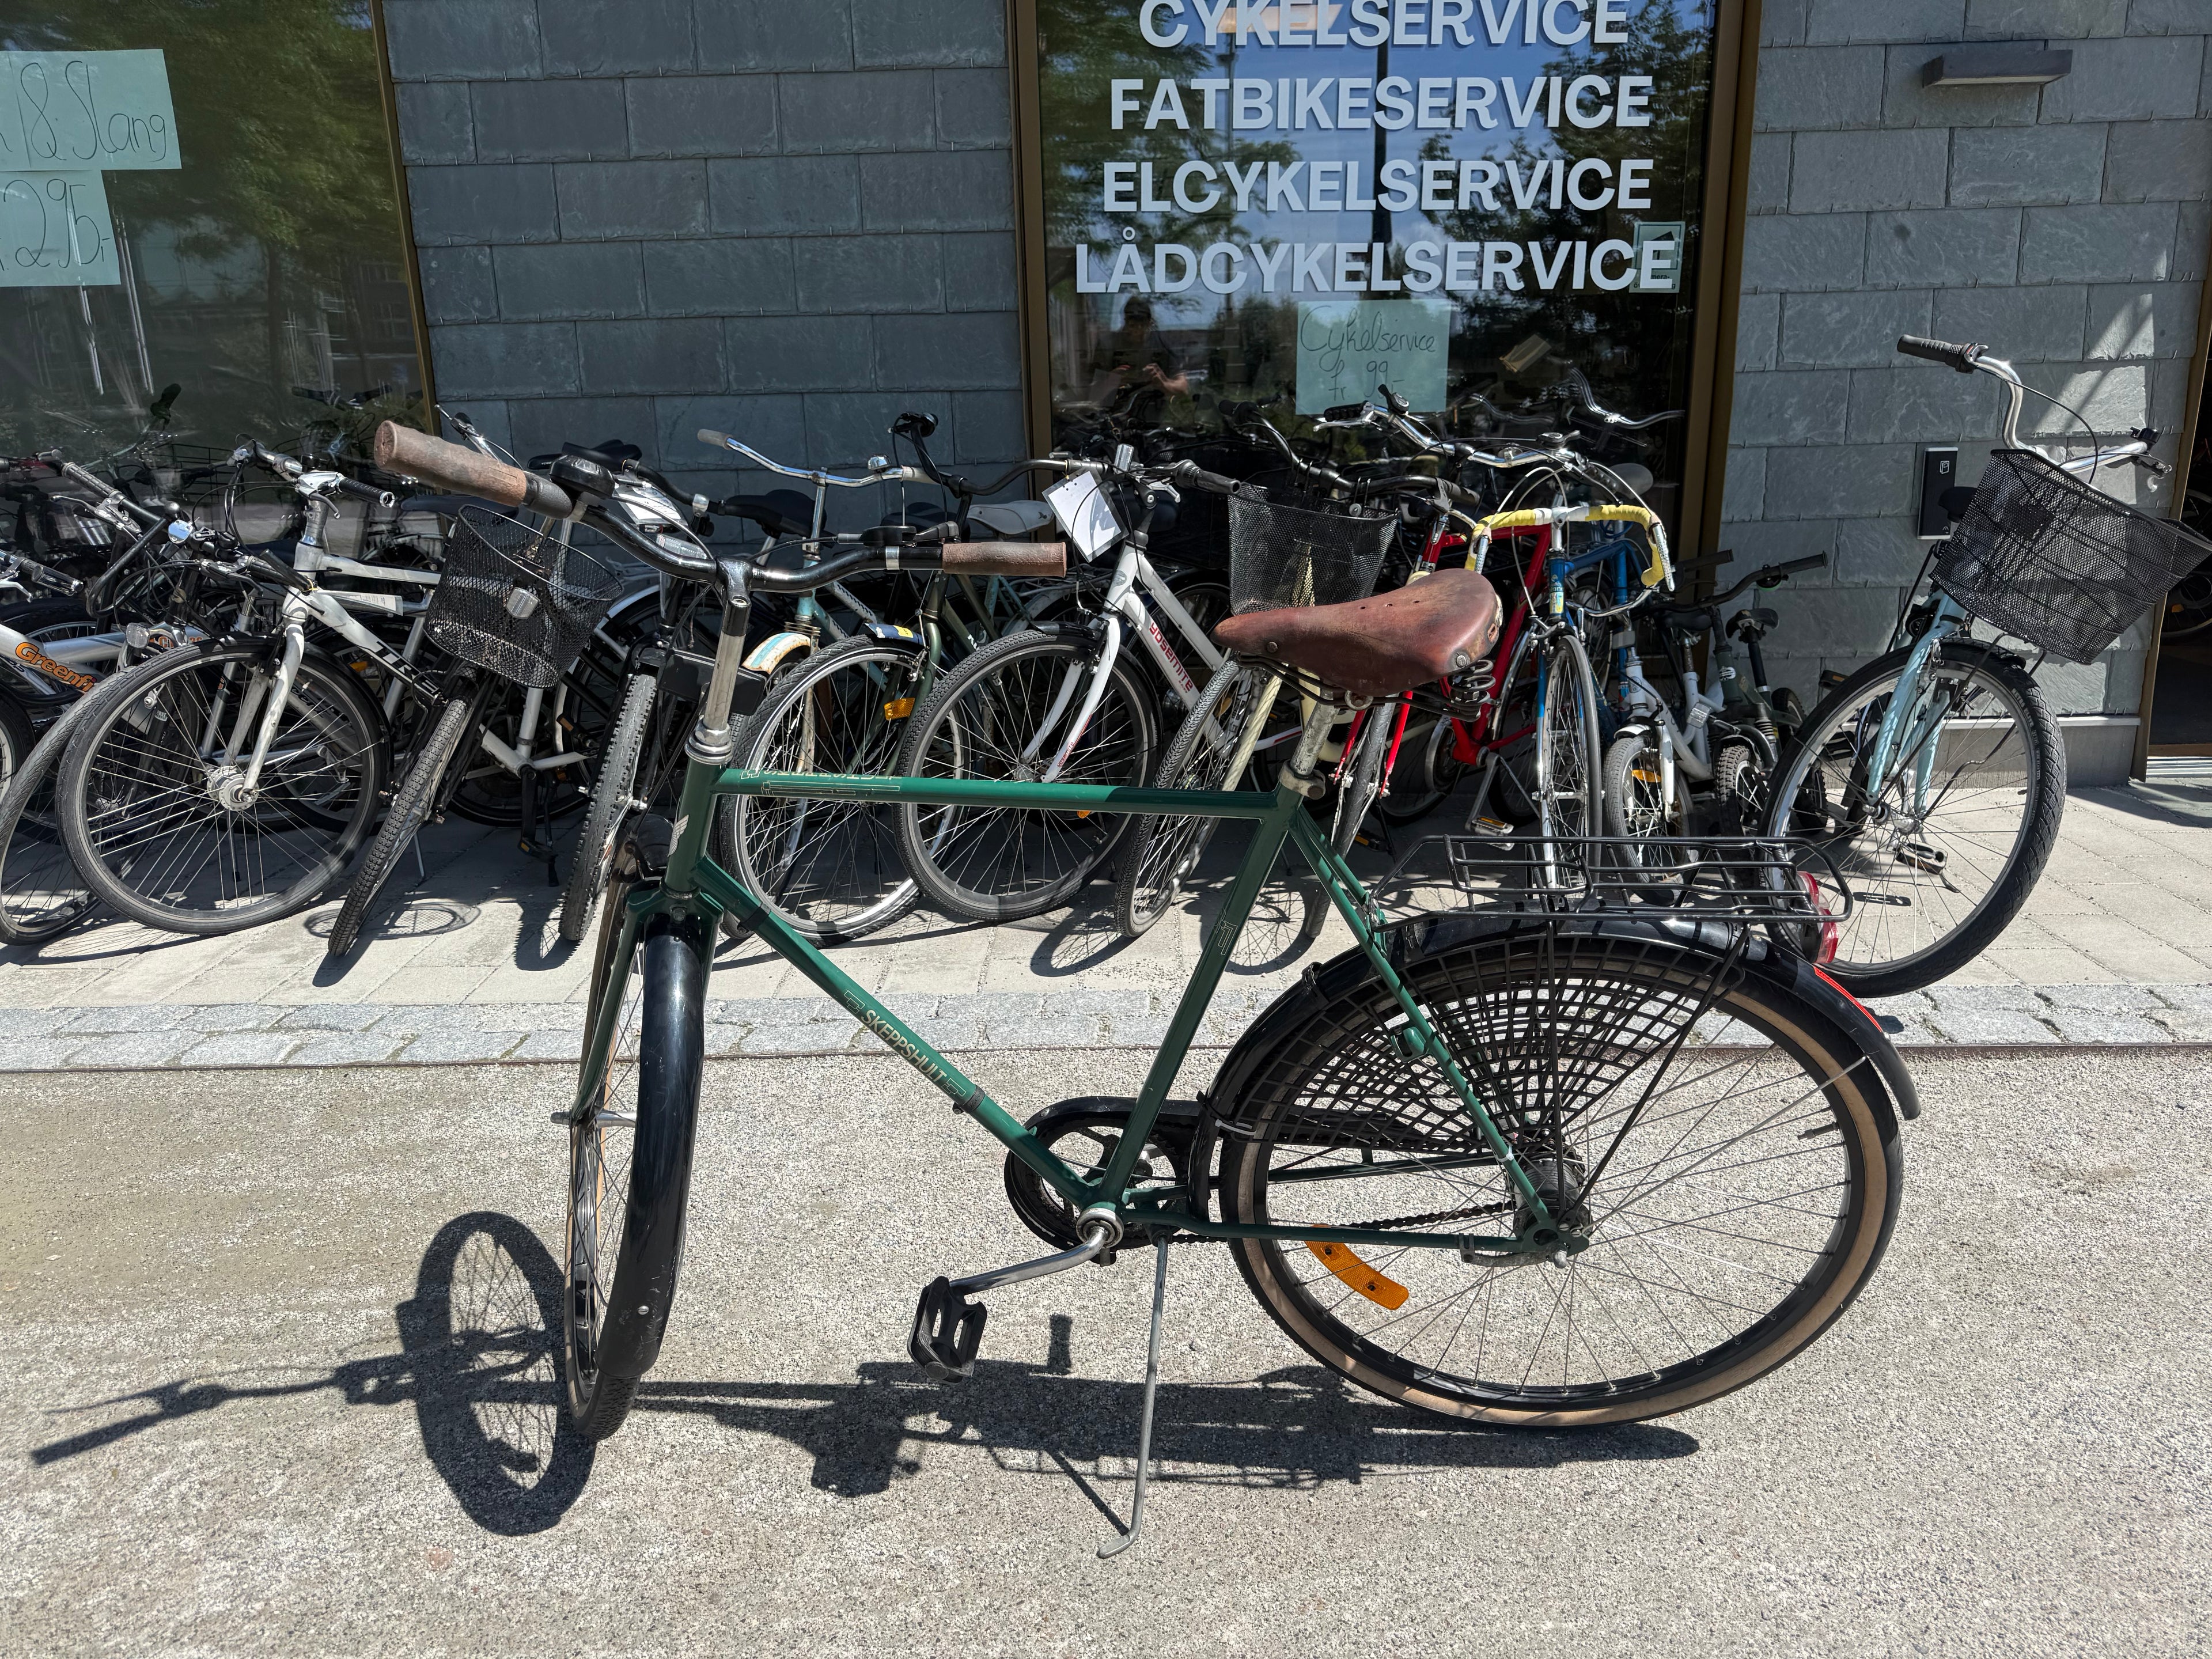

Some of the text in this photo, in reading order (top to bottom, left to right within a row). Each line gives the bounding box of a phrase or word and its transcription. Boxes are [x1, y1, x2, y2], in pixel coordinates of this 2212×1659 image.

[1139, 0, 1629, 48] CYKELSERVICE
[1110, 74, 1652, 131] FATBIKESERVICE
[1103, 158, 1654, 213] ELCYKELSERVICE
[1075, 226, 1675, 294] LÅDCYKELSERVICE
[1300, 305, 1436, 372] Cykelservice
[375, 640, 441, 694] TRE
[861, 1009, 948, 1082] SKEPPSHULT
